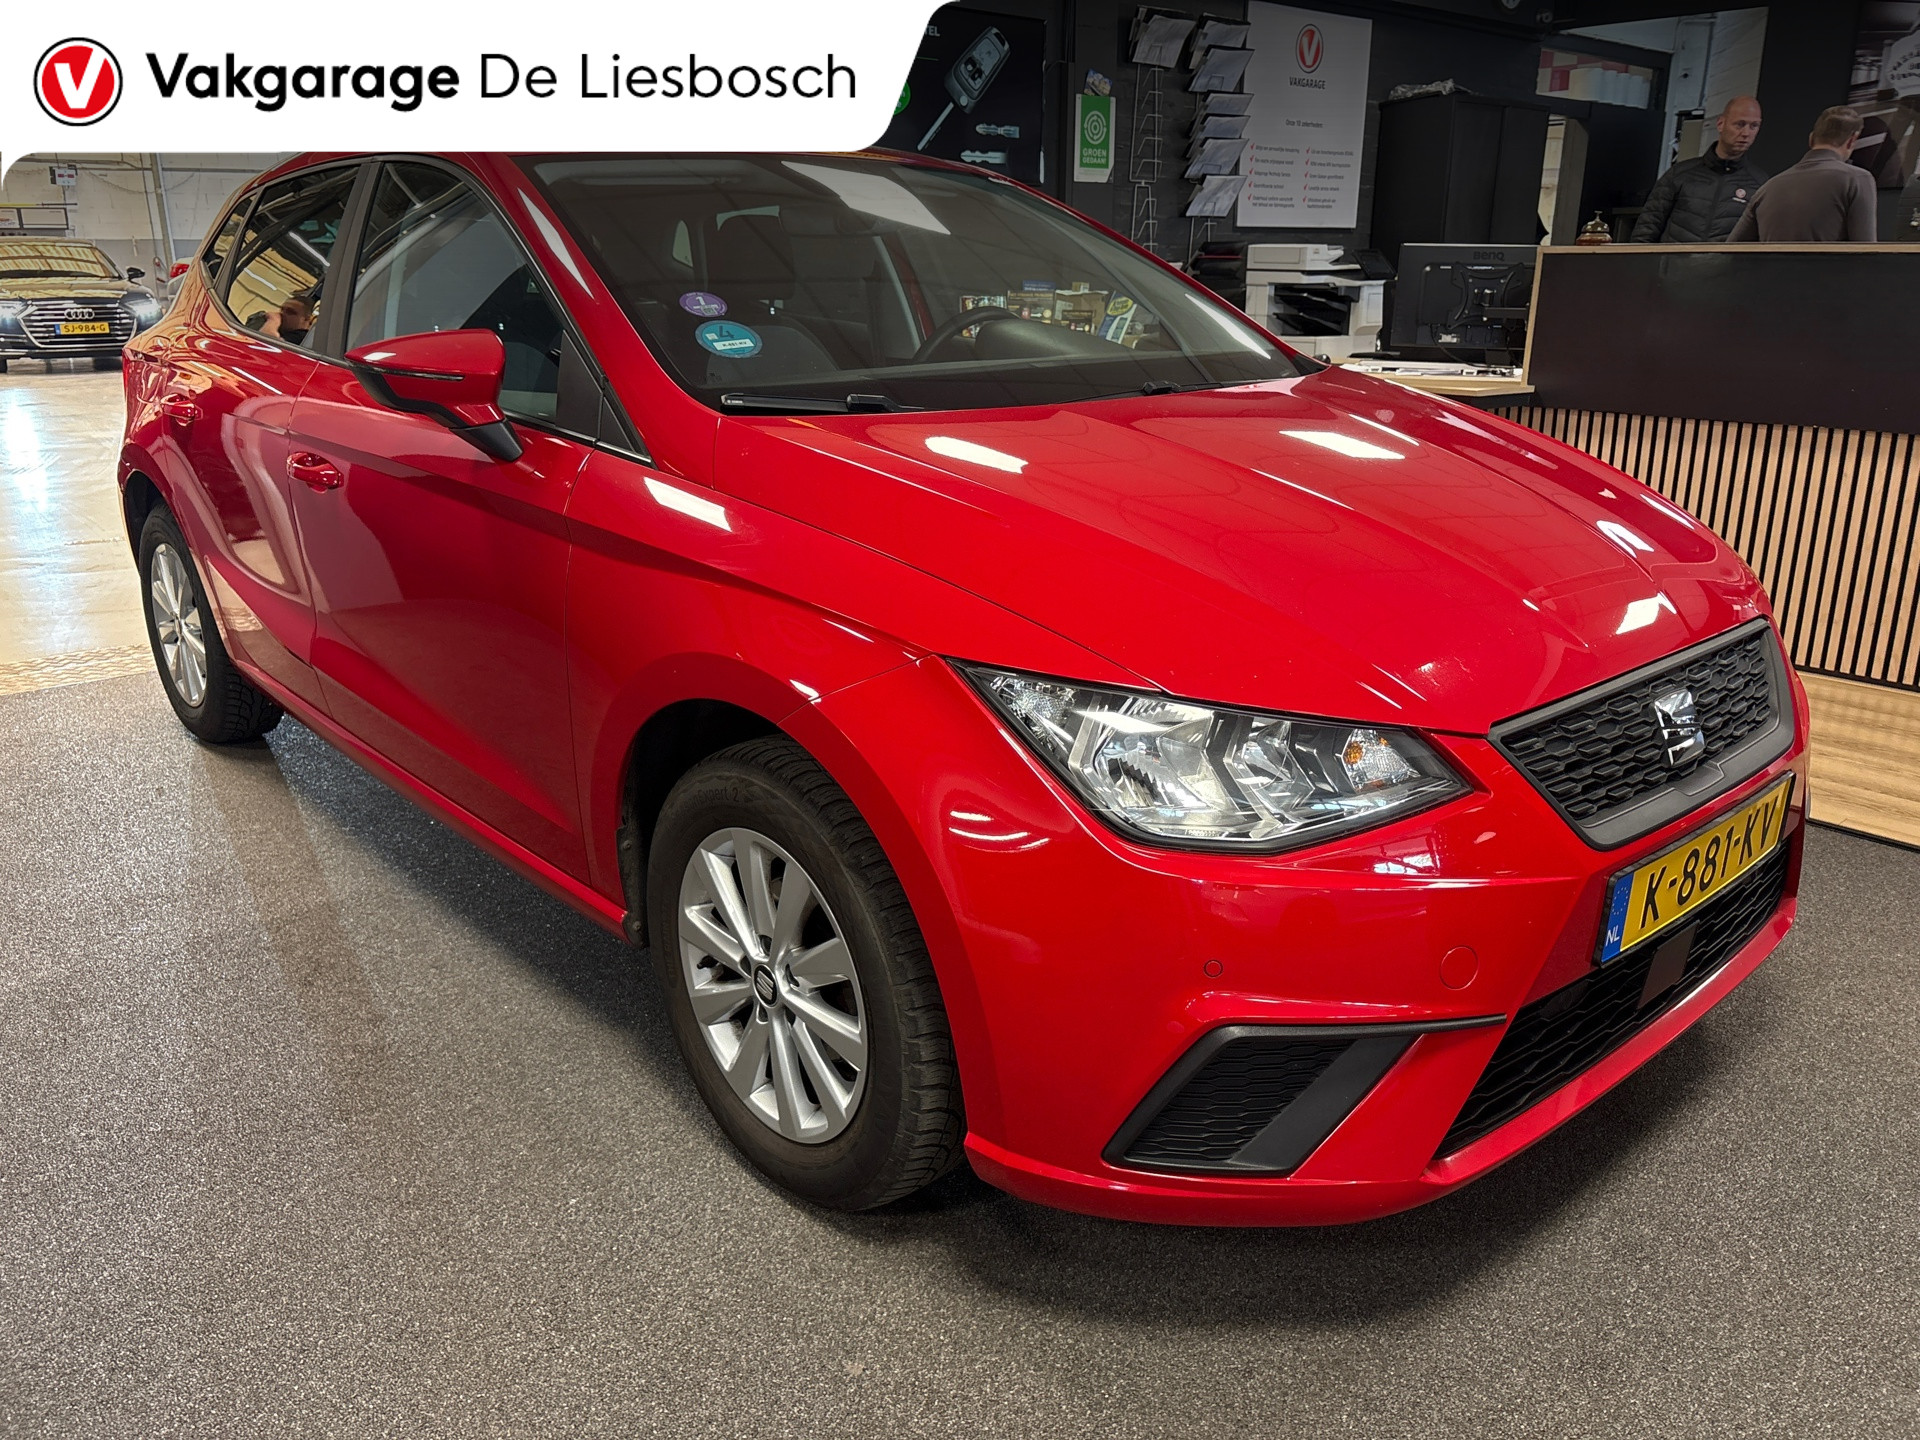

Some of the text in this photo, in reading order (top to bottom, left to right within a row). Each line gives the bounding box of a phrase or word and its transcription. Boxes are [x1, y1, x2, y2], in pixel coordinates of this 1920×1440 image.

[1289, 77, 1326, 90] VAKGARAGE
[1082, 148, 1107, 157] GROEN
[63, 324, 106, 333] SJ-984-G
[1640, 795, 1779, 930] K-881-KV
[1605, 925, 1620, 947] NL
